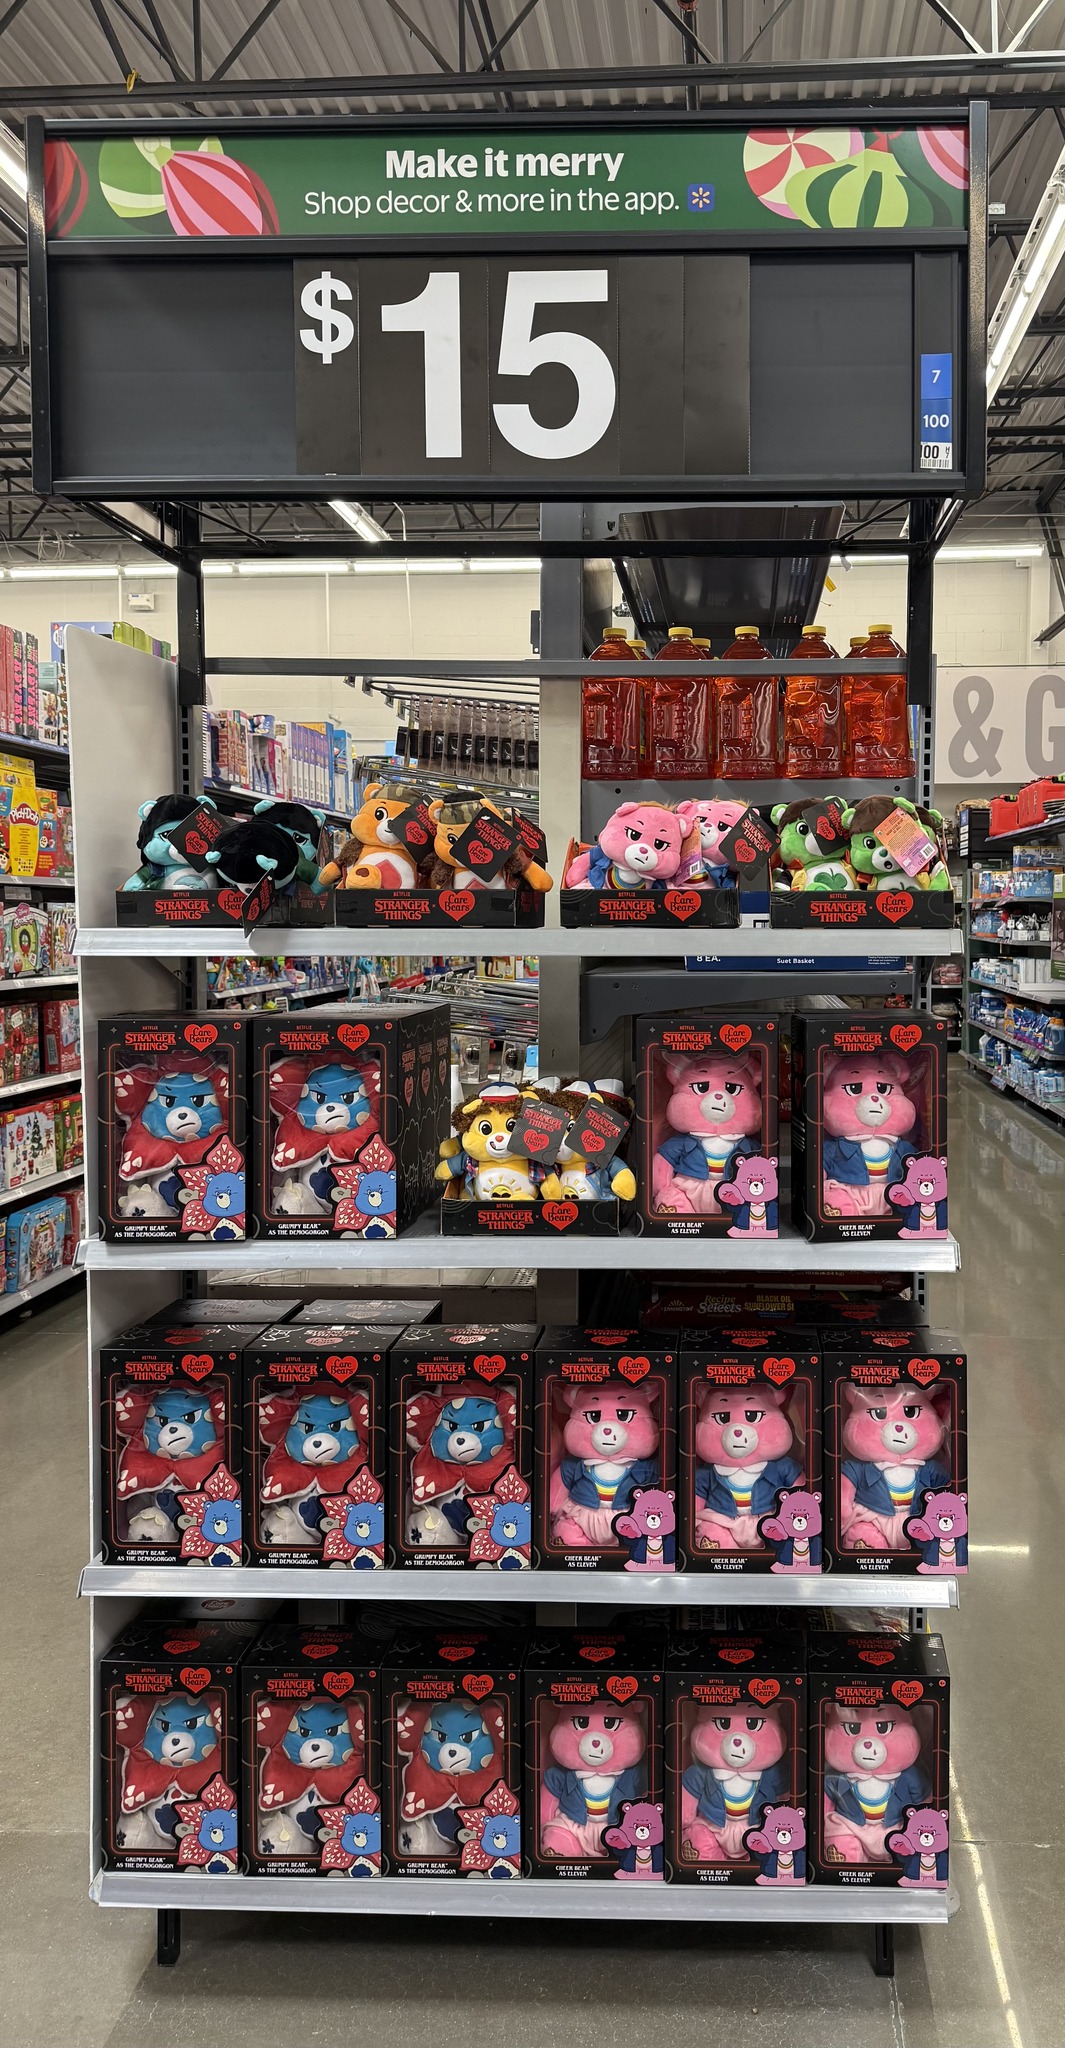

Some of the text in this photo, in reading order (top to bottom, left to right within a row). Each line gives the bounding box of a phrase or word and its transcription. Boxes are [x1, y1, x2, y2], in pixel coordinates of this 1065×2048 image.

[385, 147, 625, 182] Make it merry
[304, 186, 680, 218] Shop decor & more in the app.
[299, 270, 616, 460] $15
[931, 369, 941, 383] 7
[923, 414, 949, 428] 100
[948, 675, 1004, 778] &
[475, 819, 513, 851] STRANGER
[477, 829, 501, 850] THINGS
[227, 894, 244, 903] Car
[448, 894, 469, 904] Care
[674, 895, 695, 905] Care
[885, 895, 907, 905] Care
[154, 900, 210, 912] STRANGER
[223, 901, 242, 911] Bea
[374, 900, 430, 912] STRANGER
[444, 902, 470, 912] Bears
[599, 900, 656, 912] STRANGER
[670, 903, 697, 912] Bears
[810, 902, 868, 914] STRANGER
[881, 903, 908, 913] Bears
[164, 911, 202, 920] THINGS
[384, 911, 422, 920] THINGS
[608, 911, 648, 920] THINGS
[819, 913, 859, 922] THINGS
[193, 1028, 211, 1036] Care
[345, 1028, 363, 1036] Care
[727, 1028, 745, 1036] Care
[897, 1028, 915, 1037] Care
[125, 1033, 176, 1044] STRANGER
[190, 1035, 215, 1043] Bears
[279, 1033, 330, 1044] STRANGER
[342, 1035, 366, 1043] Bears
[662, 1033, 712, 1044] STRANGER
[724, 1035, 748, 1043] Bears
[833, 1034, 883, 1045] STRANGER
[894, 1035, 918, 1043] Bears
[134, 1043, 169, 1051] THINGS
[288, 1043, 322, 1051] THINGS
[671, 1043, 705, 1051] THINGS
[842, 1043, 875, 1052] THINGS
[551, 1206, 572, 1215] Care
[477, 1211, 534, 1223] STRANGER
[547, 1213, 574, 1222] Bears
[488, 1221, 526, 1230] THINGS
[704, 1294, 736, 1305] Recipe
[697, 1302, 742, 1314] Selects
[744, 1302, 786, 1311] SUNFLOWER
[190, 1359, 208, 1367] Care
[334, 1360, 351, 1368] Care
[482, 1360, 500, 1368] Care
[625, 1361, 644, 1369] Care
[770, 1362, 789, 1370] Care
[915, 1363, 934, 1371] Care
[125, 1363, 174, 1374] STRANGER
[268, 1365, 318, 1376] STRANGER
[331, 1367, 355, 1375] Bears
[416, 1364, 466, 1375] STRANGER
[561, 1365, 610, 1376] STRANGER
[706, 1366, 755, 1377] STRANGER
[850, 1367, 900, 1378] STRANGER
[912, 1369, 936, 1377] Bears
[133, 1373, 167, 1381] THINGS
[277, 1374, 311, 1382] THINGS
[425, 1373, 459, 1381] THINGS
[569, 1374, 603, 1382] THINGS
[714, 1375, 748, 1384] THINGS
[859, 1376, 893, 1384] THINGS
[187, 1671, 205, 1679] Care
[125, 1675, 173, 1686] STRANGER
[185, 1678, 208, 1686] Bears
[331, 1676, 348, 1684] Care
[470, 1678, 488, 1686] Care
[613, 1680, 632, 1688] Care
[266, 1680, 315, 1691] STRANGER
[328, 1682, 351, 1690] Bears
[406, 1683, 455, 1693] STRANGER
[467, 1684, 490, 1692] Bears
[550, 1684, 599, 1695] STRANGER
[756, 1682, 774, 1690] Care
[900, 1684, 918, 1692] Care
[275, 1690, 309, 1698] THINGS
[415, 1691, 448, 1699] THINGS
[611, 1687, 634, 1695] Bears
[692, 1686, 741, 1697] STRANGER
[753, 1689, 776, 1697] Bears
[835, 1688, 884, 1698] STRANGER
[896, 1691, 919, 1699] Bears
[558, 1694, 592, 1702] THINGS
[700, 1695, 733, 1704] THINGS
[844, 1697, 877, 1705] THINGS
